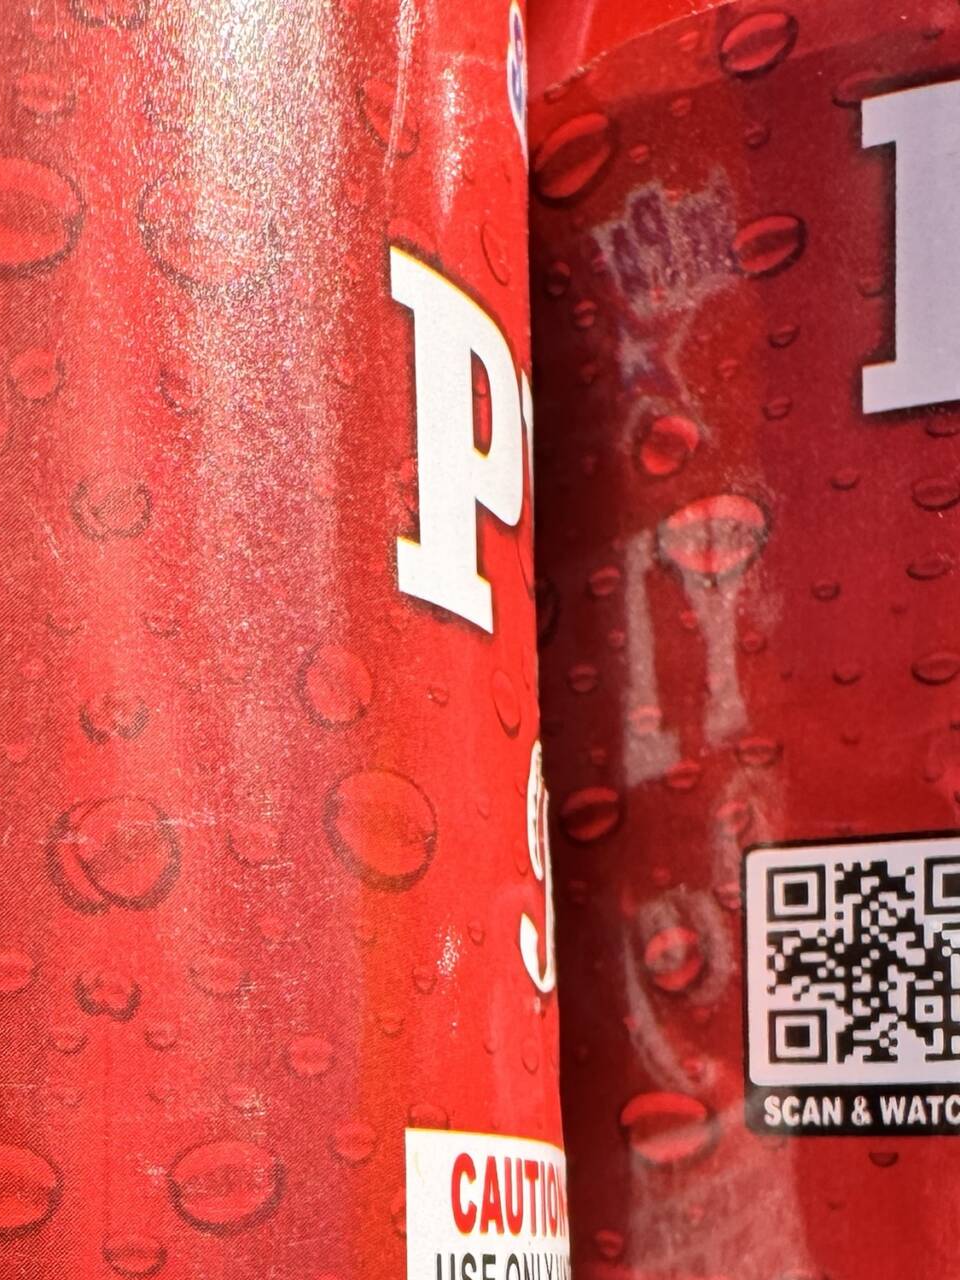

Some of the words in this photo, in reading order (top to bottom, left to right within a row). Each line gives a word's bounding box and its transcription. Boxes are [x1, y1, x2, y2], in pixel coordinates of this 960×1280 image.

[390, 247, 533, 633] P
[763, 1095, 841, 1127] SCAN
[851, 1095, 872, 1127] &
[880, 1094, 960, 1127] WATC
